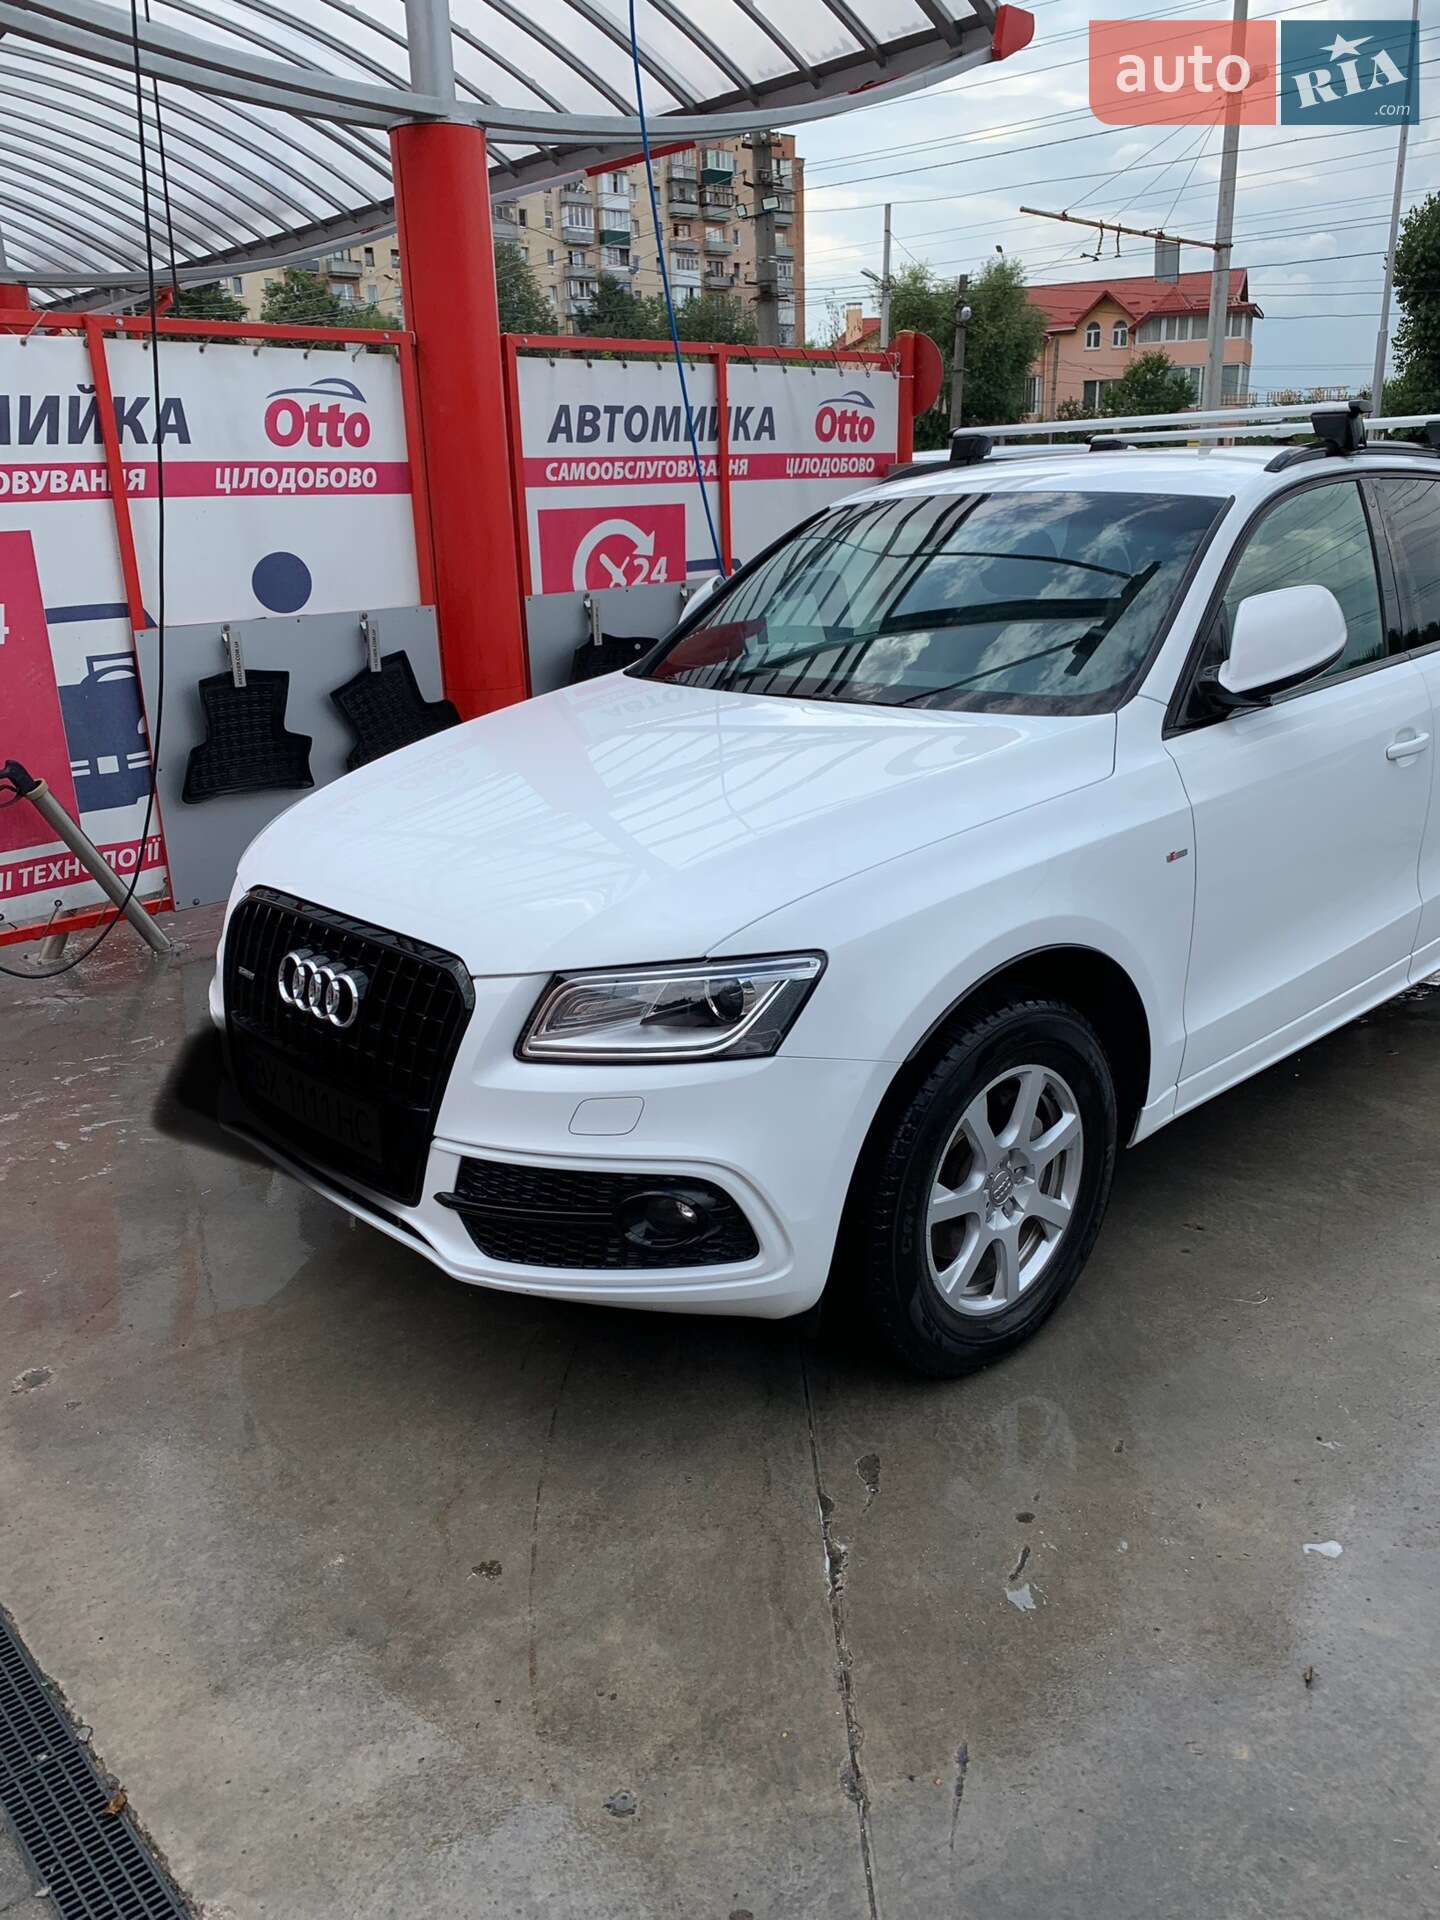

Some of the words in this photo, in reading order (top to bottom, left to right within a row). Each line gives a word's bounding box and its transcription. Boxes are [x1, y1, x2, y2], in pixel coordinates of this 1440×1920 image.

[0, 384, 191, 445] ИЙКА
[265, 398, 370, 448] Otto
[815, 406, 875, 443] Otto
[0, 468, 146, 496] ВУВАНЯ
[216, 467, 377, 494] ЦІЛОДОБОВО
[545, 458, 749, 481] САМООБСЛУГОВУВАНЯ
[786, 457, 875, 478] ЦІЛОДОБОВО
[18, 837, 161, 888] ТЕХНЛОІЇ
